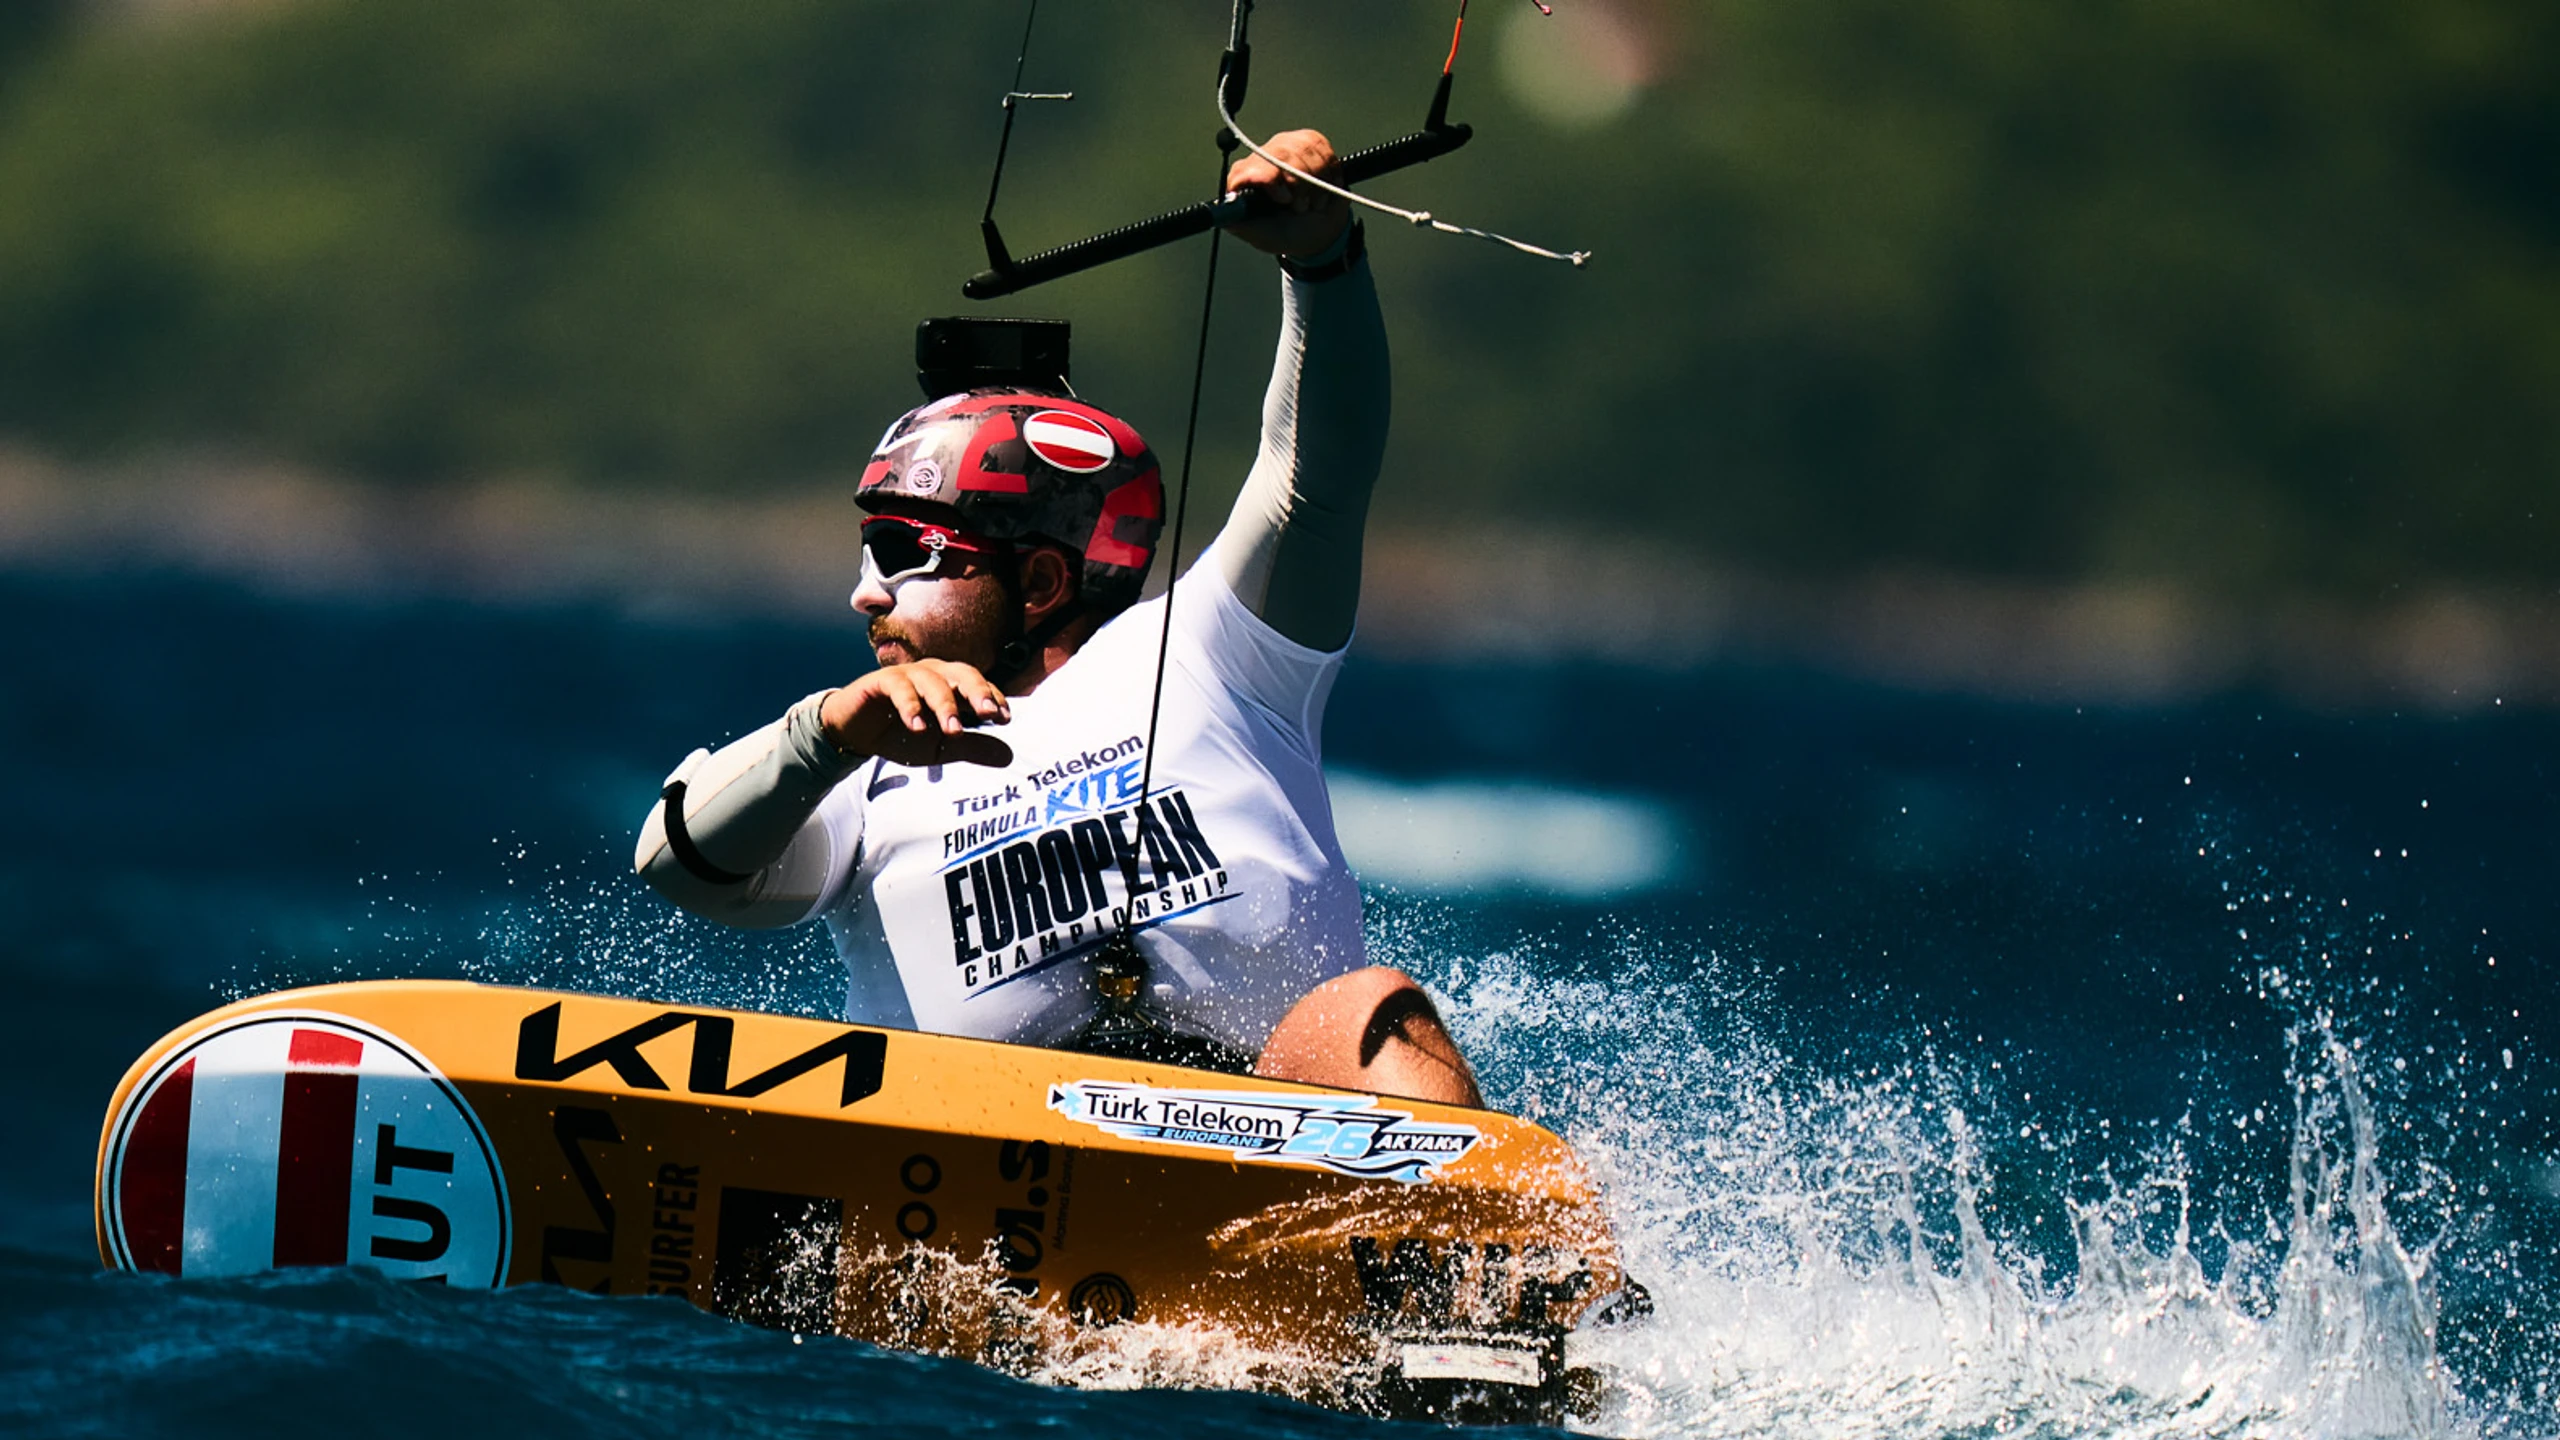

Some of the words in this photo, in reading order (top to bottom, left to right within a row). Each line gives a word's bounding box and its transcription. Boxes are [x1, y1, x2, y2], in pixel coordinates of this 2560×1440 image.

[943, 805, 1037, 859] FORMULA
[1045, 758, 1146, 824] KITE
[952, 784, 1022, 818] Türk
[1027, 734, 1145, 788] Telekom
[943, 790, 1223, 967] EUROPEAN
[963, 870, 1229, 988] CHAMPIONSHIP
[514, 1001, 888, 1109] KIA
[1085, 1092, 1149, 1122] Türk
[1157, 1100, 1284, 1138] Telekom
[1161, 1127, 1265, 1149] EUROPEANS
[1281, 1117, 1380, 1160] 26
[1373, 1133, 1464, 1151] AKYAKA
[369, 1123, 455, 1286] UT
